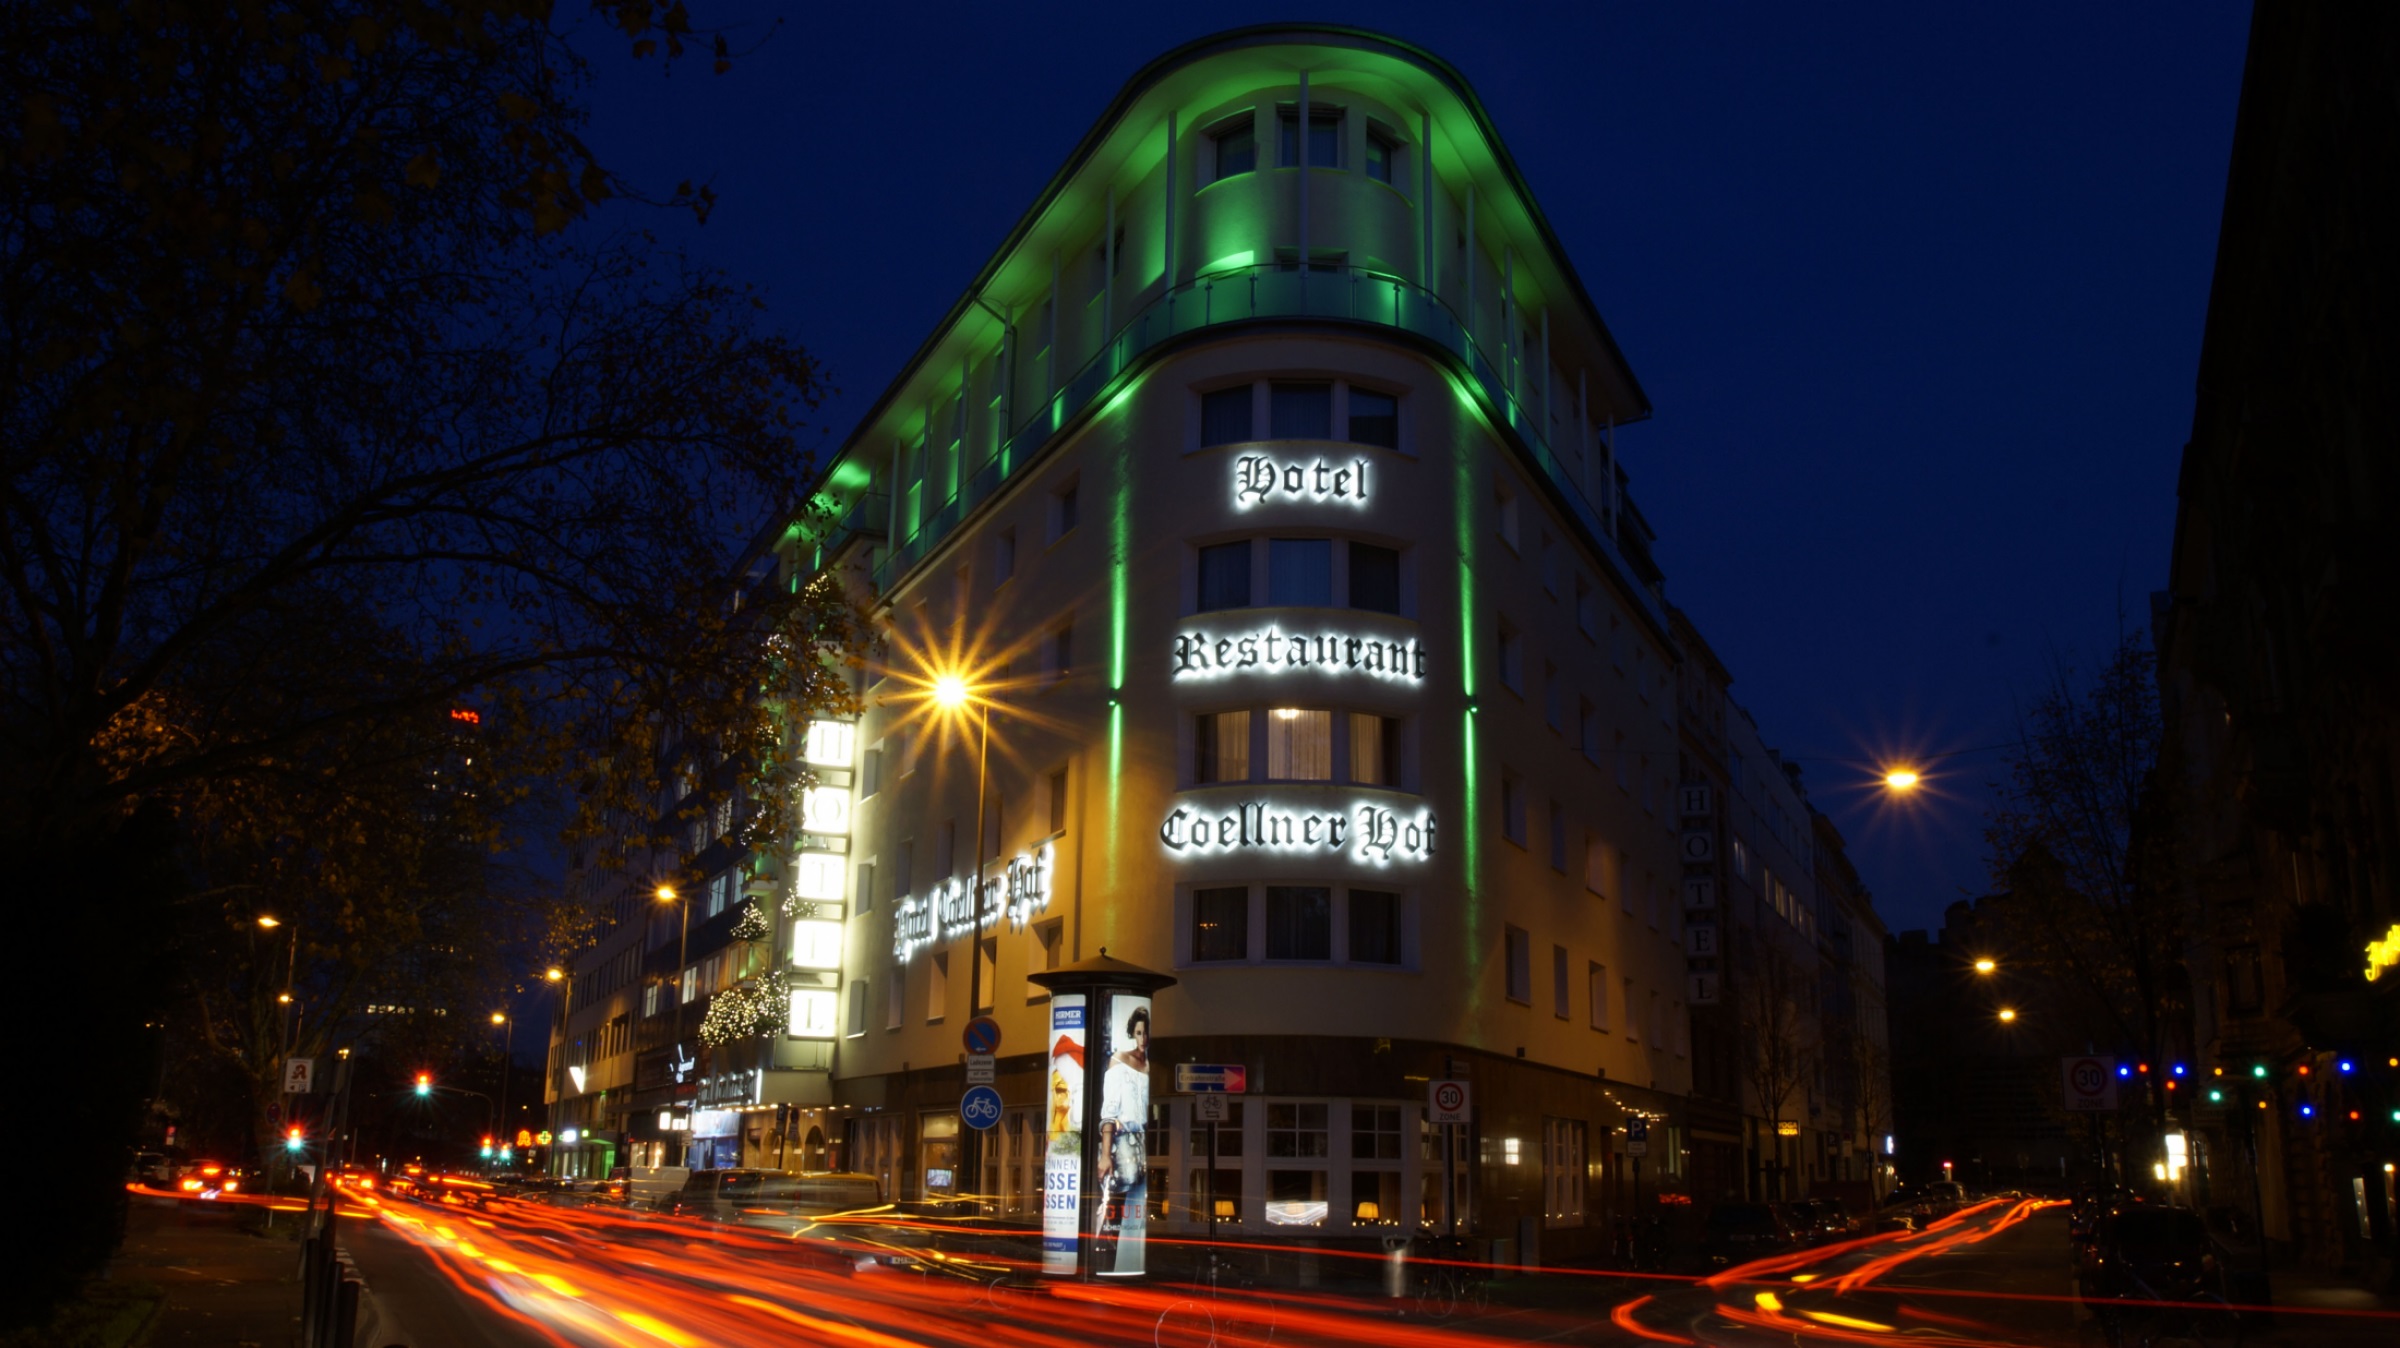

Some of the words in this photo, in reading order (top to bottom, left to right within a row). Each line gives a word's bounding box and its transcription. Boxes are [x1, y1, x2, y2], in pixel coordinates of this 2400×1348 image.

[1236, 456, 1370, 504] Hotel
[1172, 626, 1427, 679] Restaurant
[1160, 802, 1348, 850] Coellner
[1358, 803, 1438, 860] Hof
[1685, 789, 1713, 1000] HOTEL
[2078, 1069, 2100, 1087] 30
[1441, 1090, 1459, 1105] 30
[2077, 1098, 2105, 1109] ZONE
[1439, 1113, 1461, 1121] ZONE
[1105, 1204, 1147, 1219] GUE
